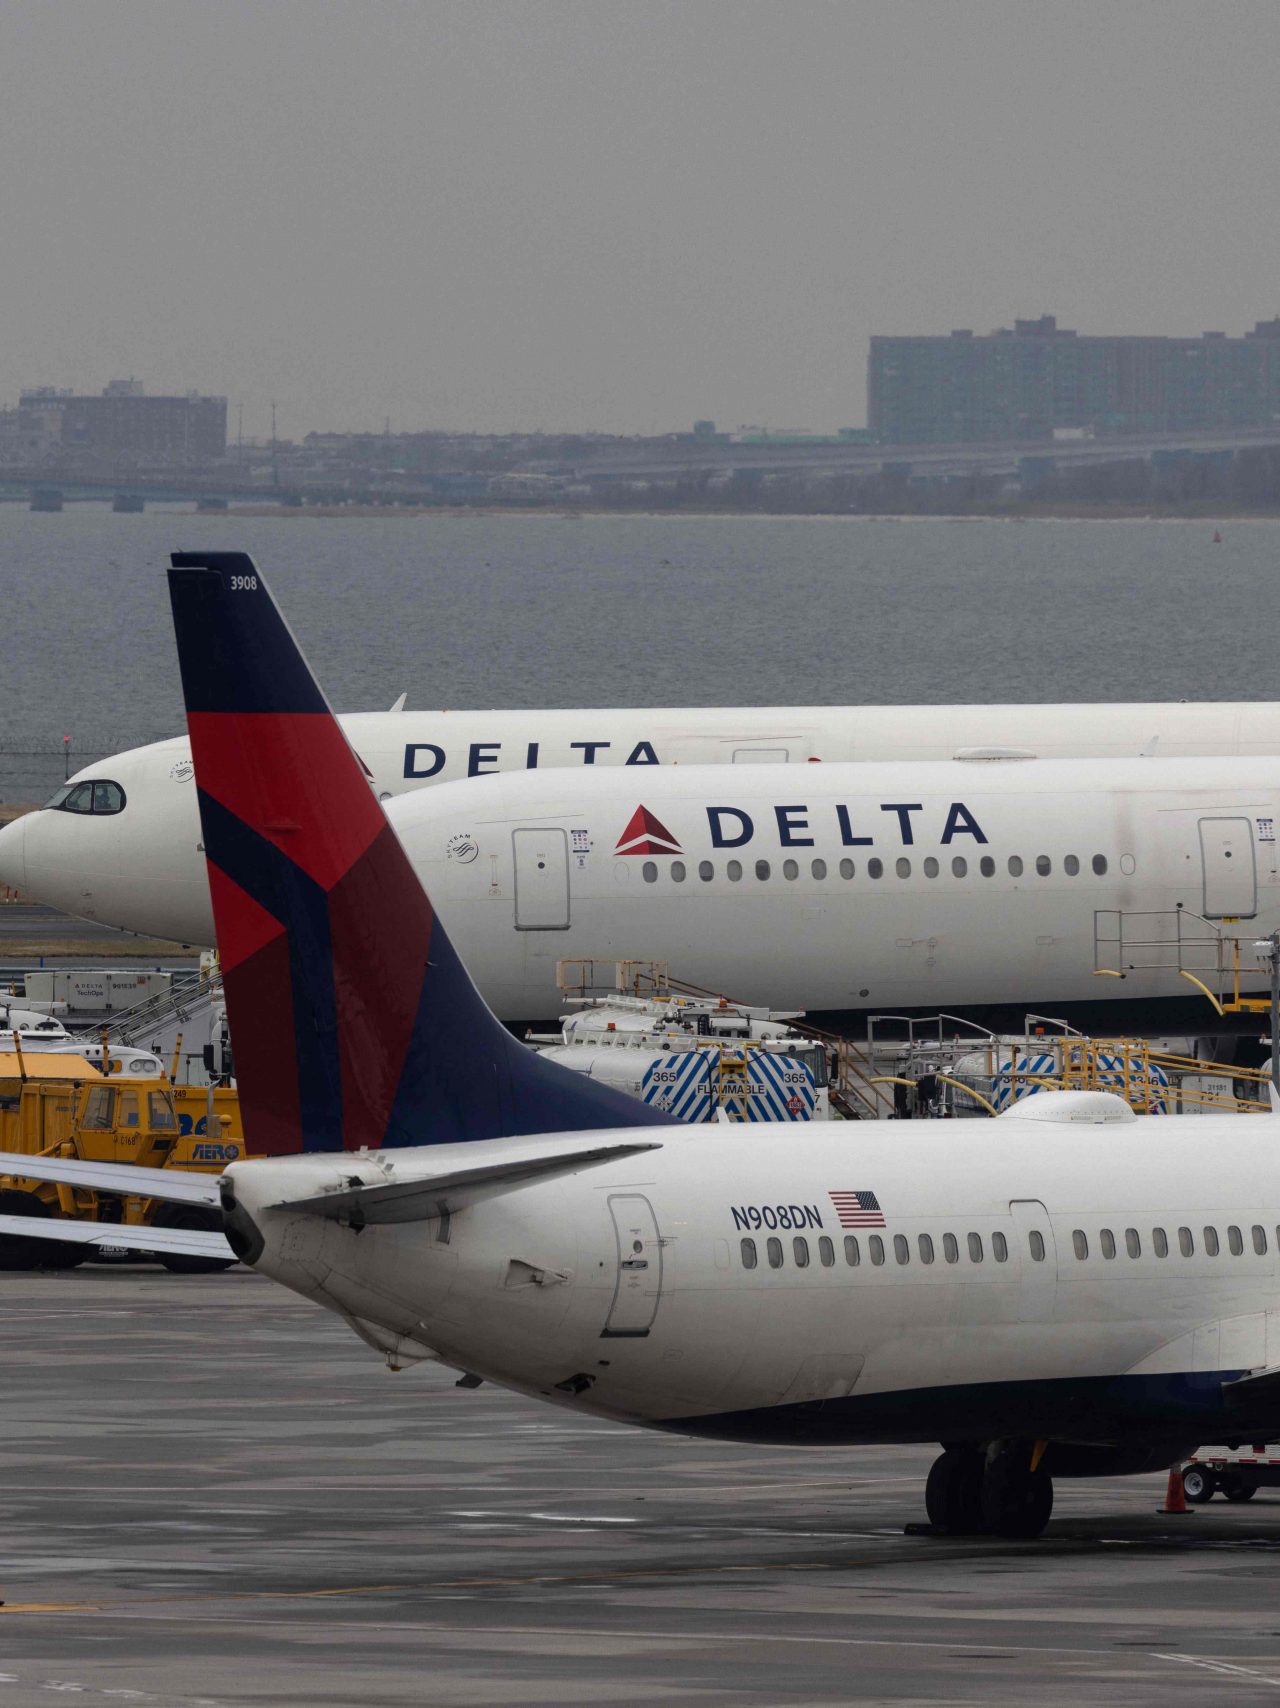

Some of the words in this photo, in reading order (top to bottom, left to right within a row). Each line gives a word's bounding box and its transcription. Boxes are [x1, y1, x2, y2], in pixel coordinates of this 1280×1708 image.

[230, 575, 257, 590] 3908
[705, 802, 989, 849] DELTA
[653, 1072, 677, 1082] 365
[784, 1073, 806, 1083] 365
[192, 1144, 240, 1160] AERO
[730, 1204, 824, 1231] N908DN
